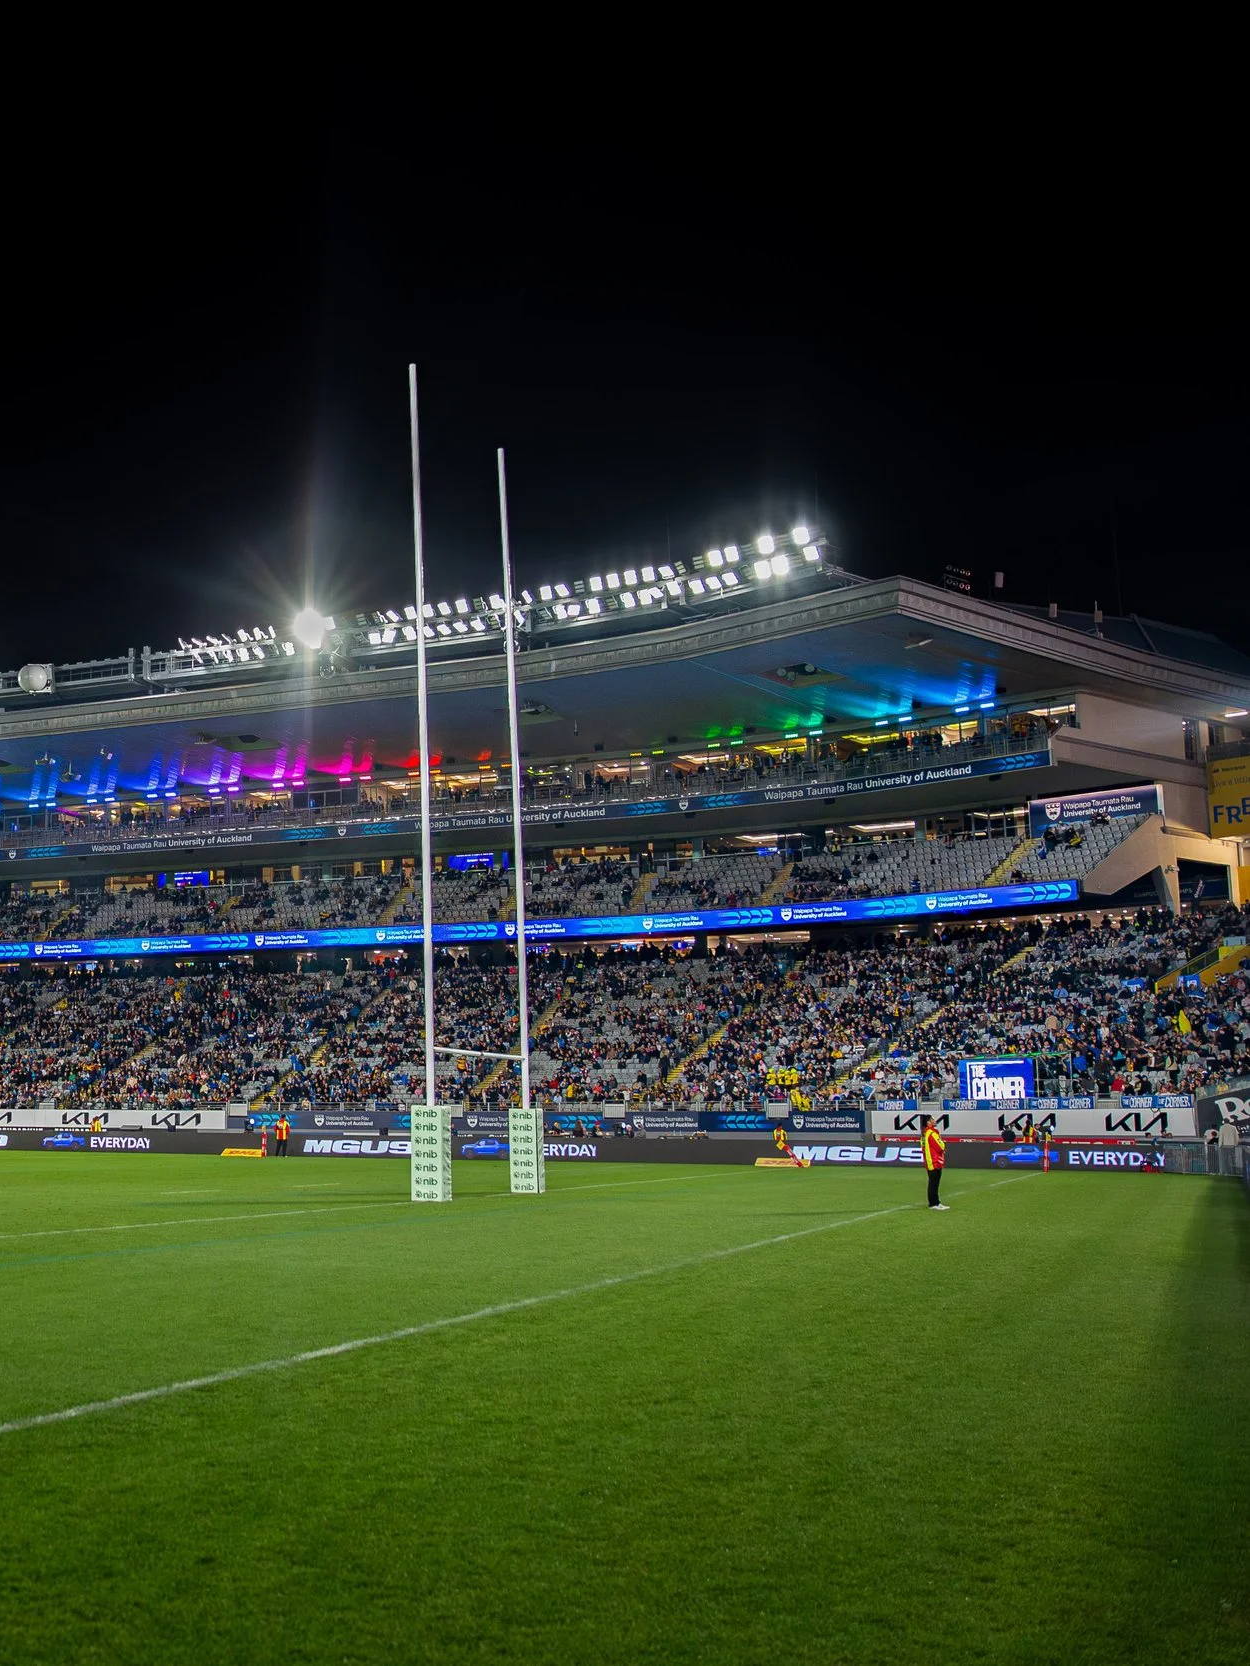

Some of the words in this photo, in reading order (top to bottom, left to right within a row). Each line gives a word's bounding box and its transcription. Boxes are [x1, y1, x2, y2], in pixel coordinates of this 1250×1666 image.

[764, 790, 803, 800] Waipapa
[806, 785, 844, 795] Taumata
[847, 782, 863, 791] Rau
[866, 775, 911, 788] University
[915, 773, 924, 781] of
[926, 765, 971, 779] Auckland
[1091, 798, 1119, 806] Taumata
[1064, 808, 1097, 817] University
[1108, 803, 1140, 811] Auckland
[451, 818, 485, 826] Taumata
[488, 816, 503, 824] Rau
[552, 811, 561, 819] of
[564, 809, 605, 818] Auckland
[92, 844, 121, 852] Waipapa
[123, 842, 151, 850] Taumata
[168, 838, 205, 847] University
[207, 836, 215, 844] of
[217, 834, 252, 843] Auckland
[971, 1065, 985, 1077] THE
[972, 1077, 1025, 1099] CORNER
[1130, 1097, 1152, 1108] CORNER
[1165, 1096, 1190, 1107] CORNER
[152, 1113, 200, 1126] KIA
[1106, 1112, 1168, 1131] KIA
[423, 1123, 437, 1131] nib
[91, 1137, 150, 1148] EVERYDAY
[423, 1137, 437, 1145] nib
[423, 1150, 437, 1158] nib
[1069, 1151, 1165, 1166] EVERYDY
[423, 1164, 437, 1172] nib
[423, 1191, 438, 1199] nib
